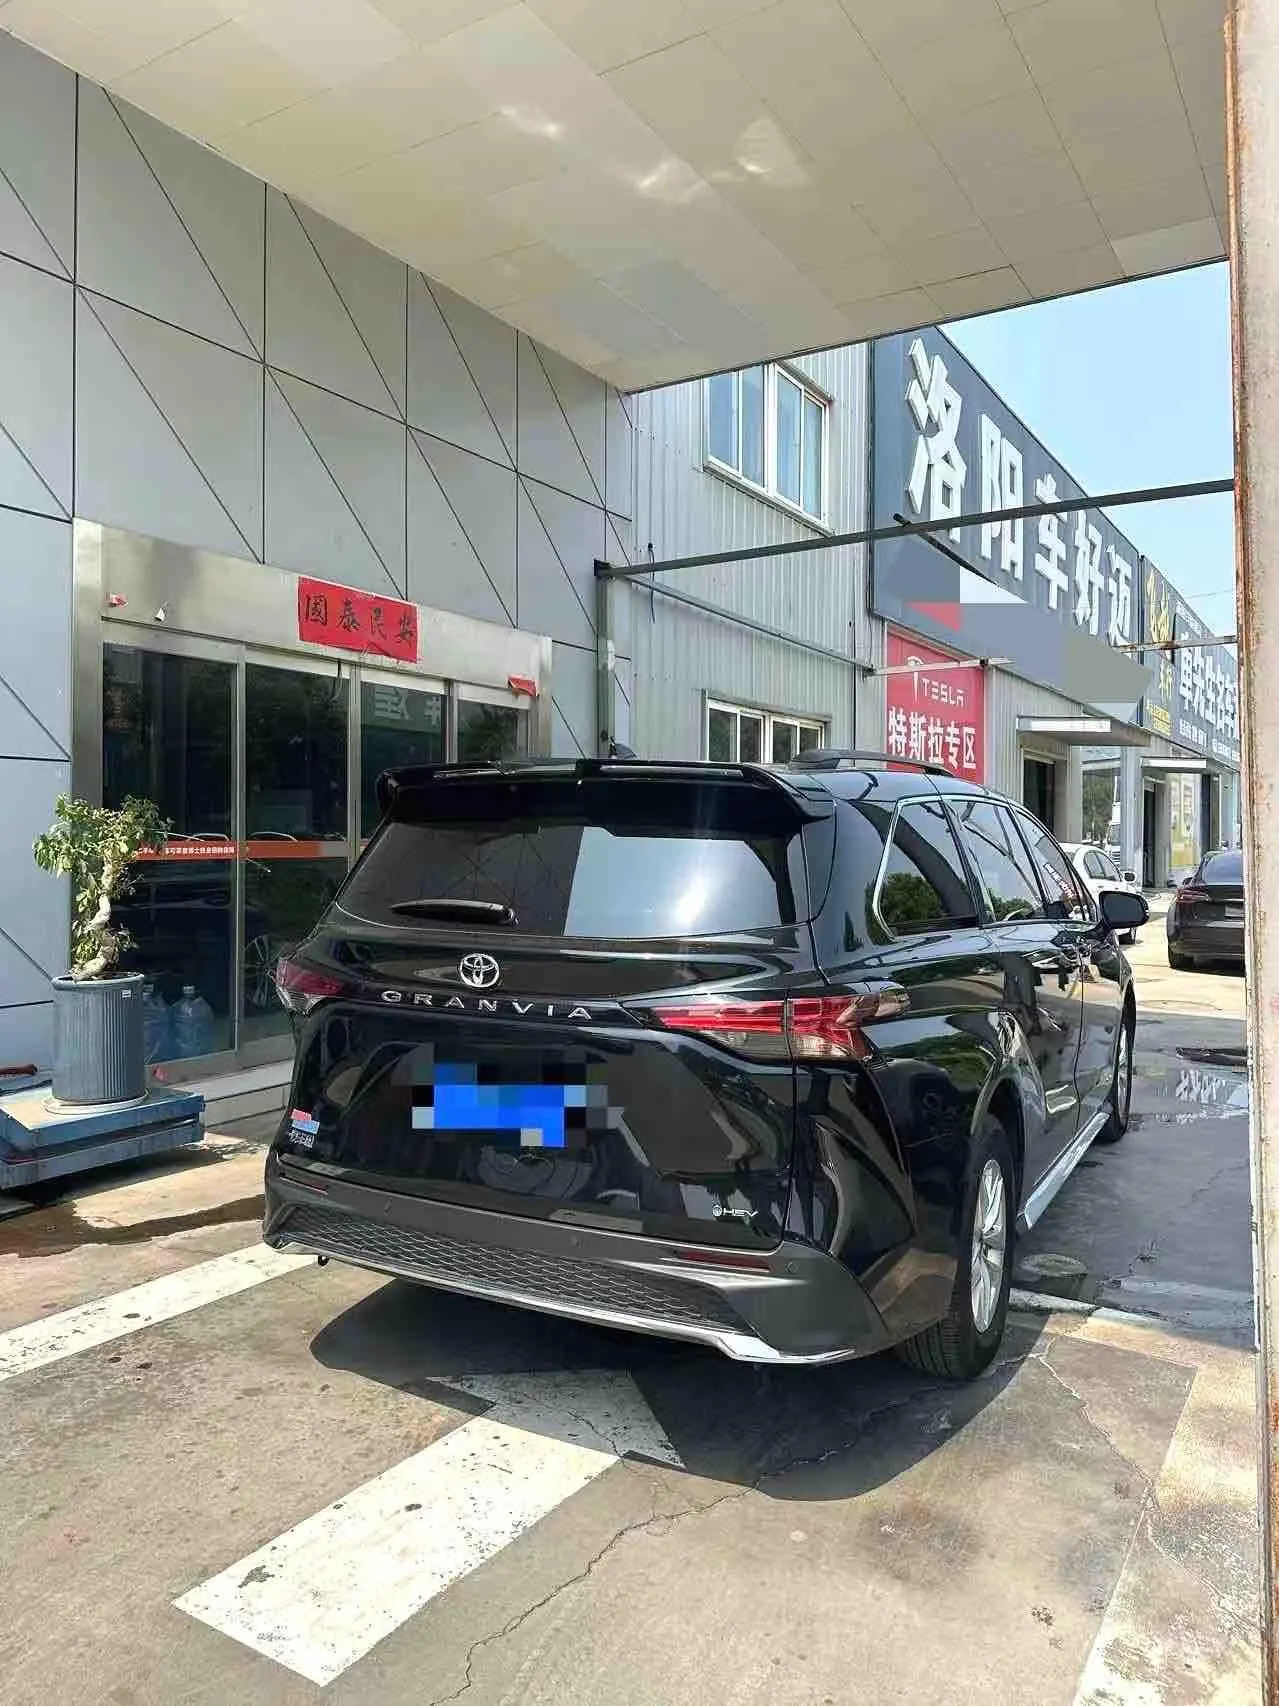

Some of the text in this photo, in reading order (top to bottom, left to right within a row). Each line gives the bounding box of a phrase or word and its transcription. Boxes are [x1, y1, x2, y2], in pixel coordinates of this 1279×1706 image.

[921, 677, 965, 707] TESLA
[888, 705, 977, 770] 特斯拉专区
[381, 989, 592, 1020] GRANVIA
[723, 1207, 758, 1217] HEV
